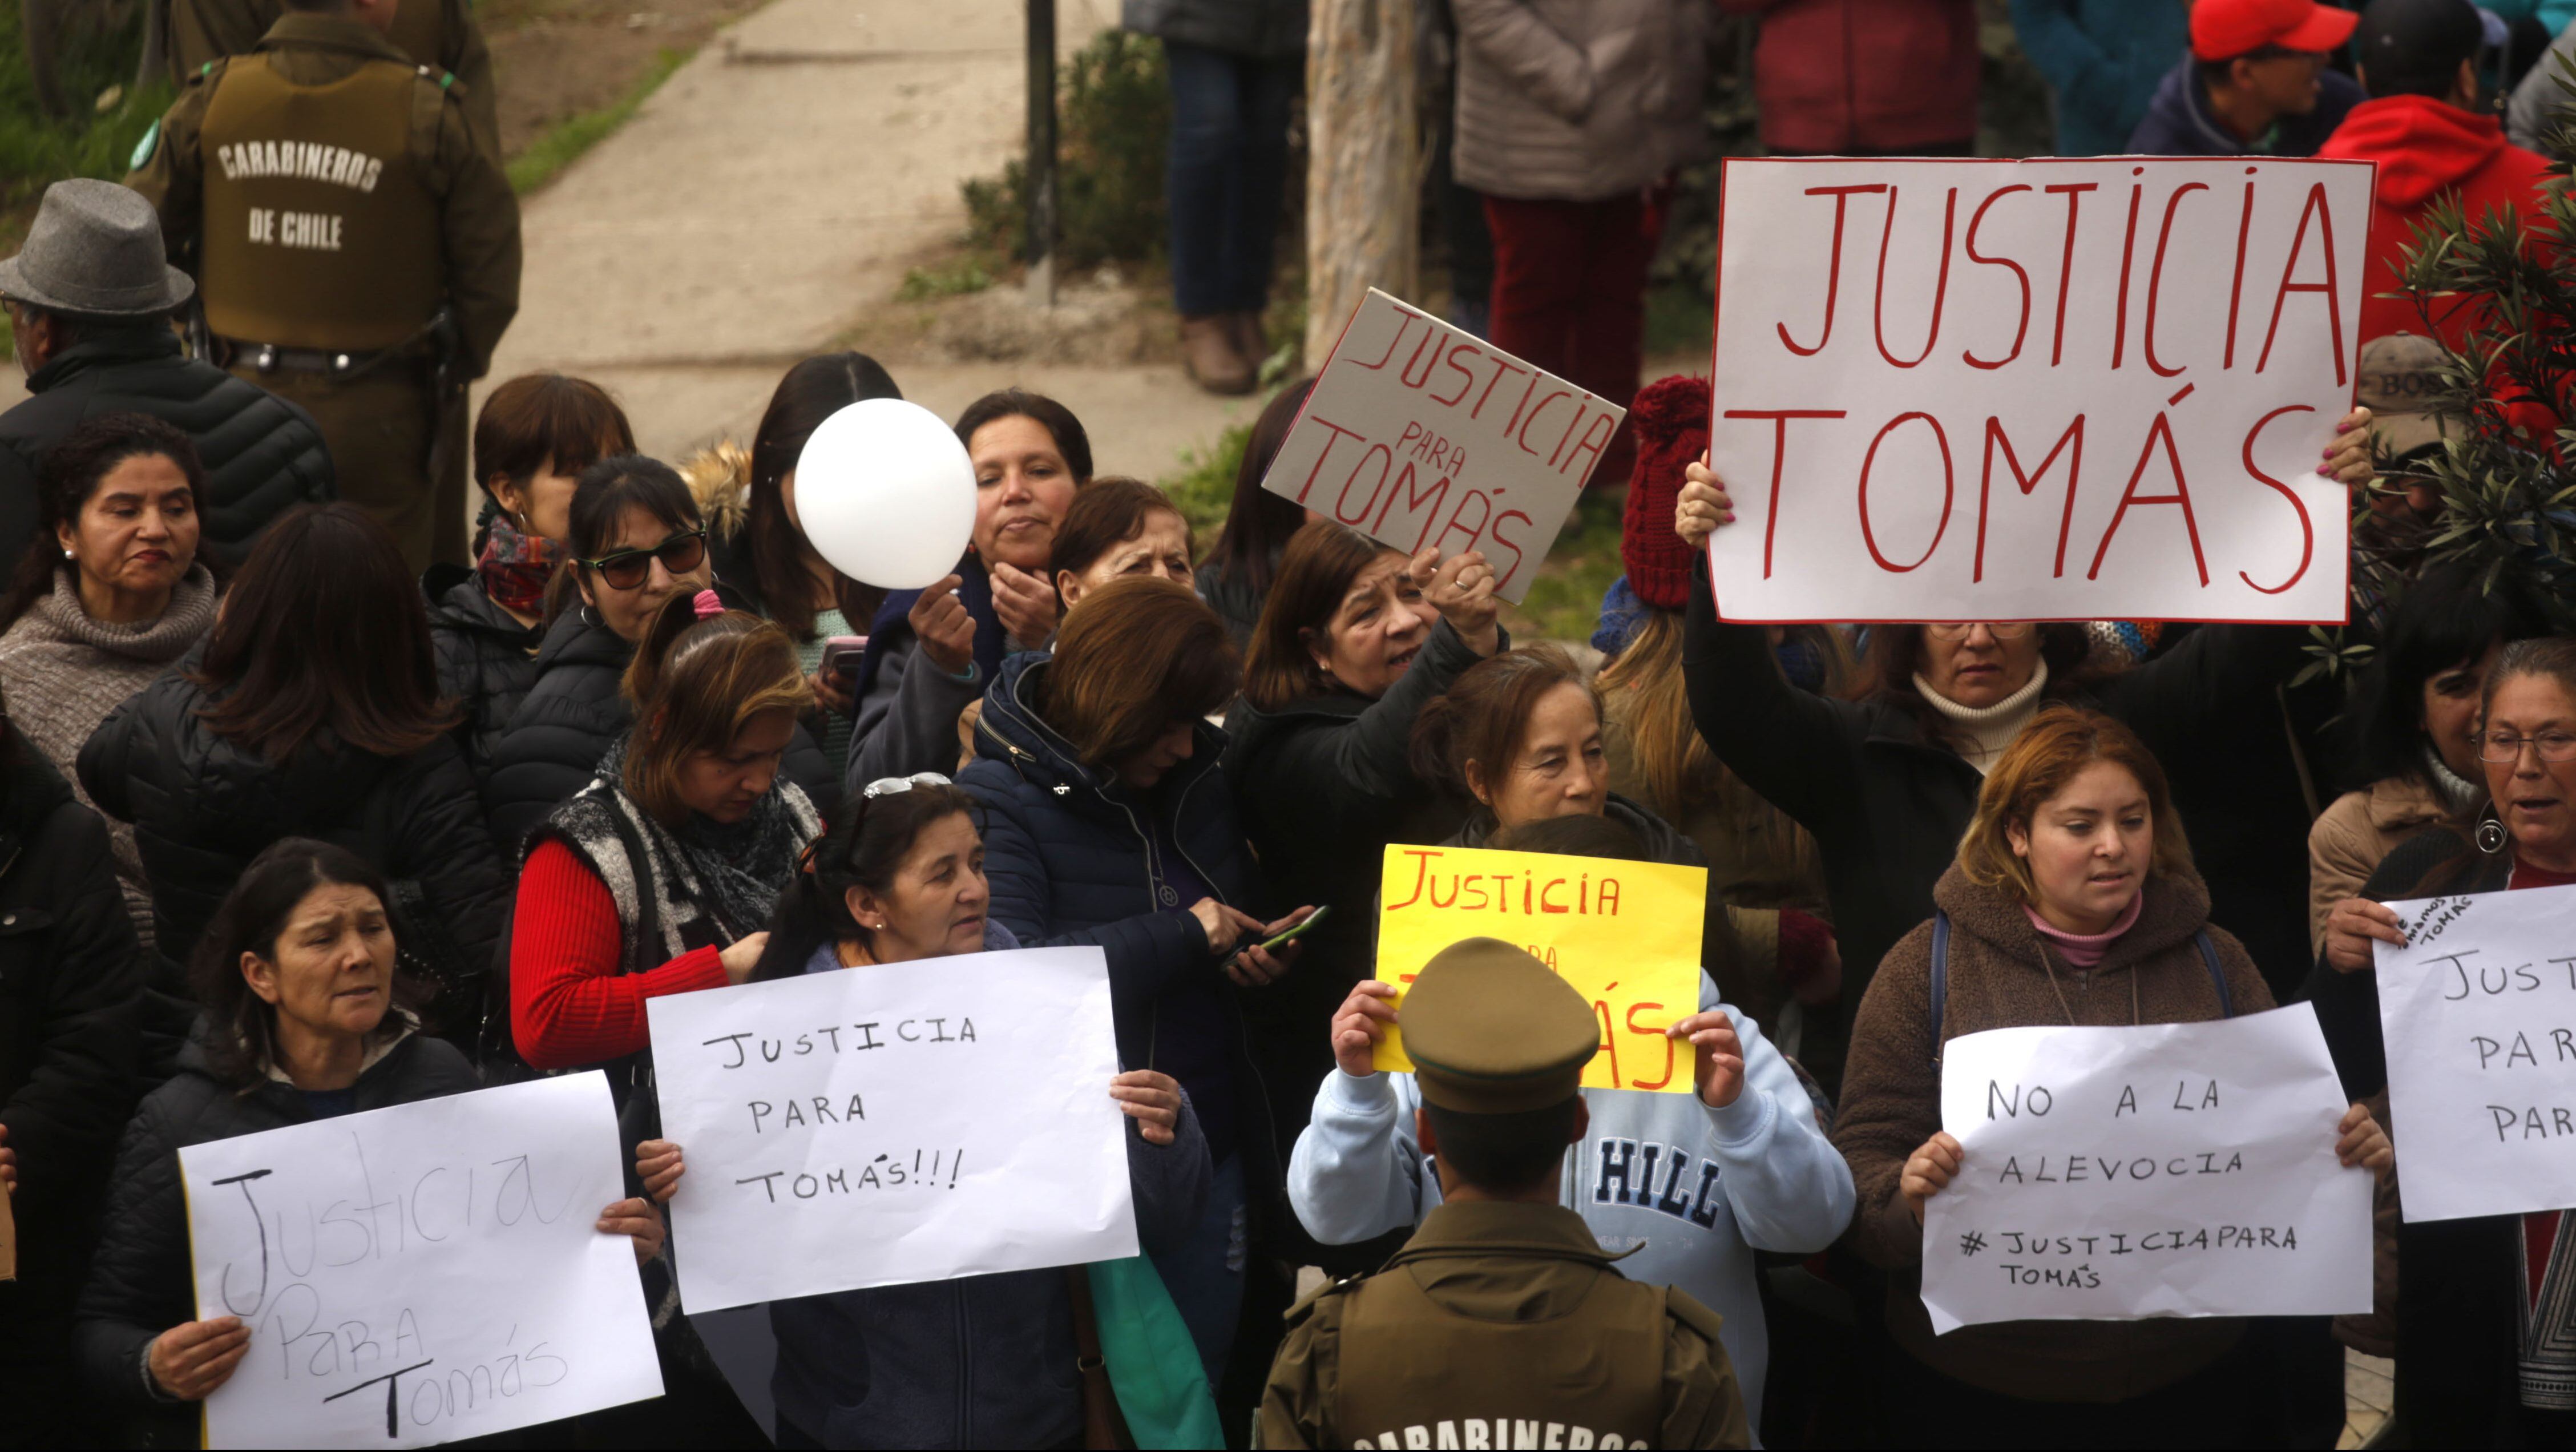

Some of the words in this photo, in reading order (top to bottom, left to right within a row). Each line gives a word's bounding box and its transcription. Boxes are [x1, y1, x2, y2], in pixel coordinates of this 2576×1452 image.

[218, 140, 382, 193] CARABINEROS
[249, 208, 274, 244] DE
[281, 212, 342, 249] CHILE
[1396, 421, 1465, 478] PARA
[1297, 416, 1533, 592] TOMÁS
[1723, 382, 2315, 594] TOMÁS
[2420, 896, 2473, 945] TOMÁS
[2417, 949, 2576, 1000] JUST
[702, 1017, 976, 1069] JUSTICIA
[2470, 1028, 2576, 1069] PAR
[748, 1094, 866, 1133] PARA
[1986, 1079, 2053, 1120] NO
[2115, 1086, 2137, 1118] A
[2174, 1080, 2219, 1110] LA
[2486, 1106, 2574, 1142] PAR
[735, 1149, 962, 1204] TOMÁS!!!
[1593, 1138, 1720, 1231] HILL
[1999, 1152, 2243, 1184] ALEVOCIA
[2000, 1263, 2101, 1289] TOMÁS
[1354, 1418, 1648, 1450] RABINER
